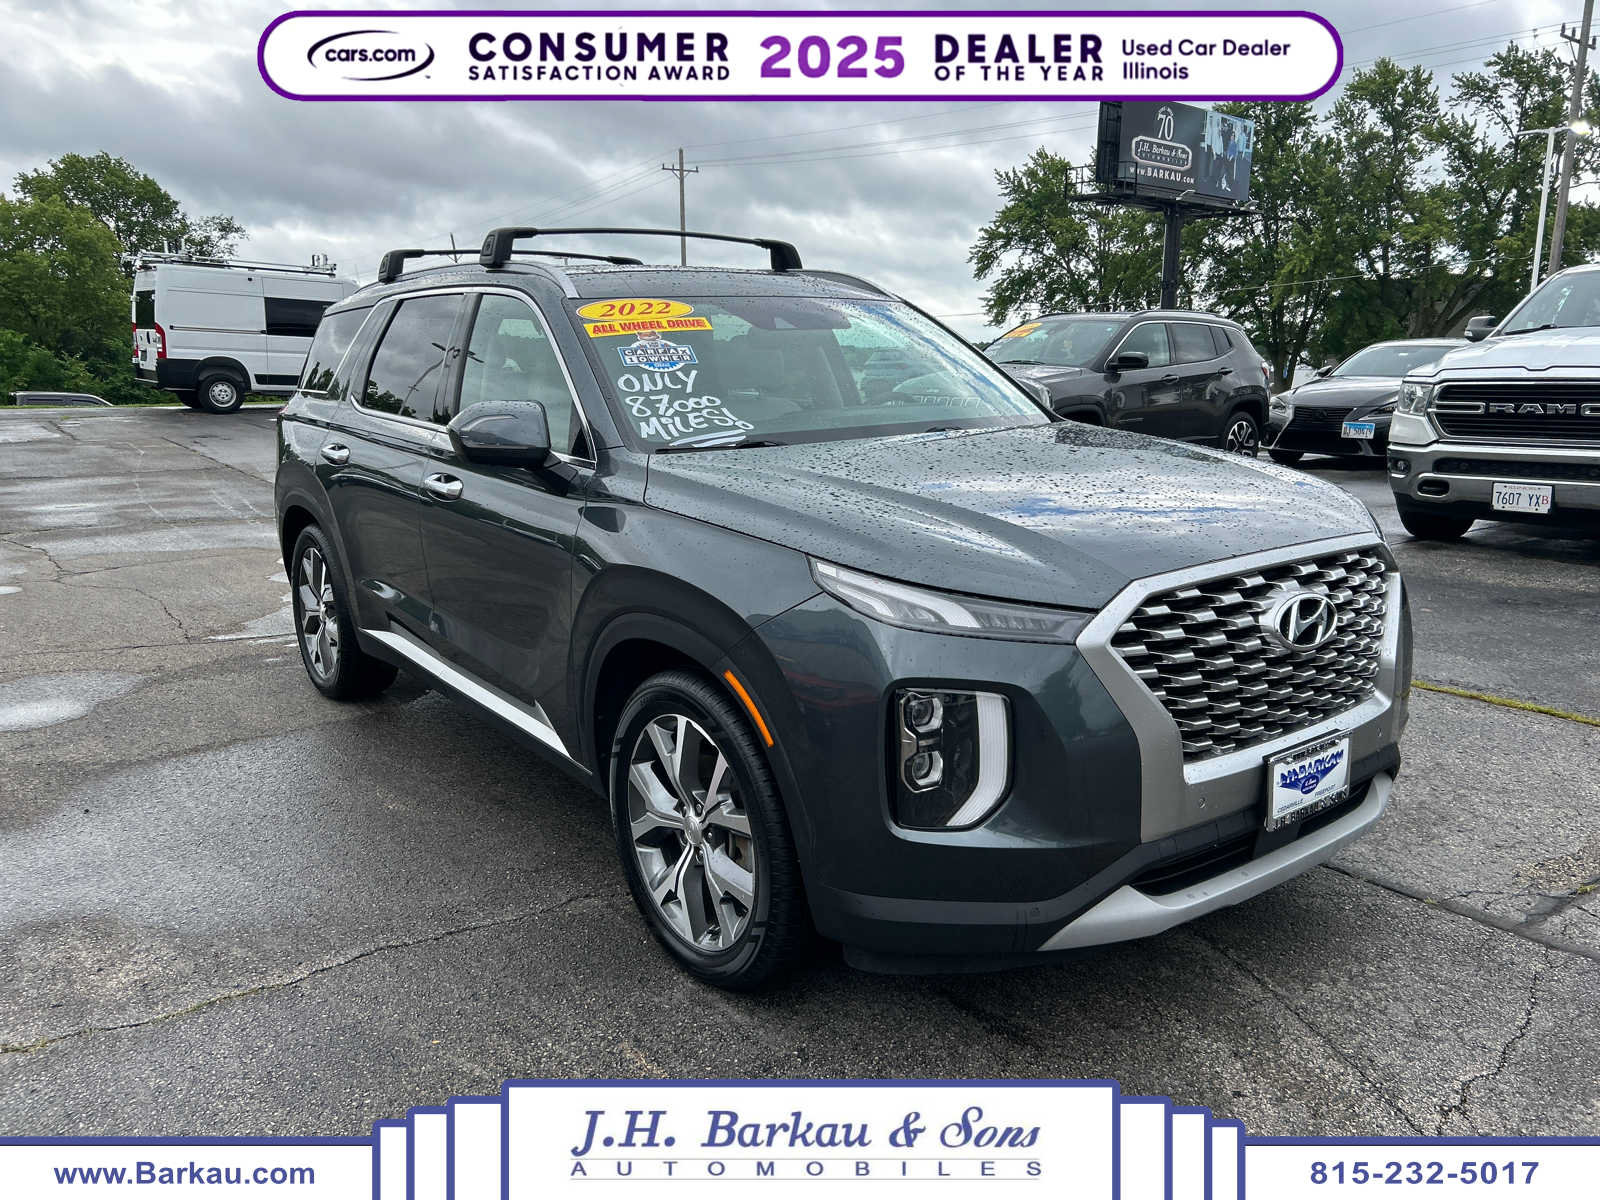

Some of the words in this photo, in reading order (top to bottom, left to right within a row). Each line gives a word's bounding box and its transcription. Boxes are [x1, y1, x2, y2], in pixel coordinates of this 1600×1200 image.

[1157, 113, 1174, 140] 70
[600, 302, 671, 317] 2022
[592, 323, 619, 335] ALL
[619, 321, 666, 332] WHEEL
[667, 319, 707, 329] DRIVE
[623, 347, 690, 356] CARFAX
[638, 354, 693, 363] OWNER
[617, 370, 698, 393] ONLY
[625, 394, 721, 418] 87,000
[1489, 403, 1577, 414] RAM
[1496, 491, 1522, 505] 7607
